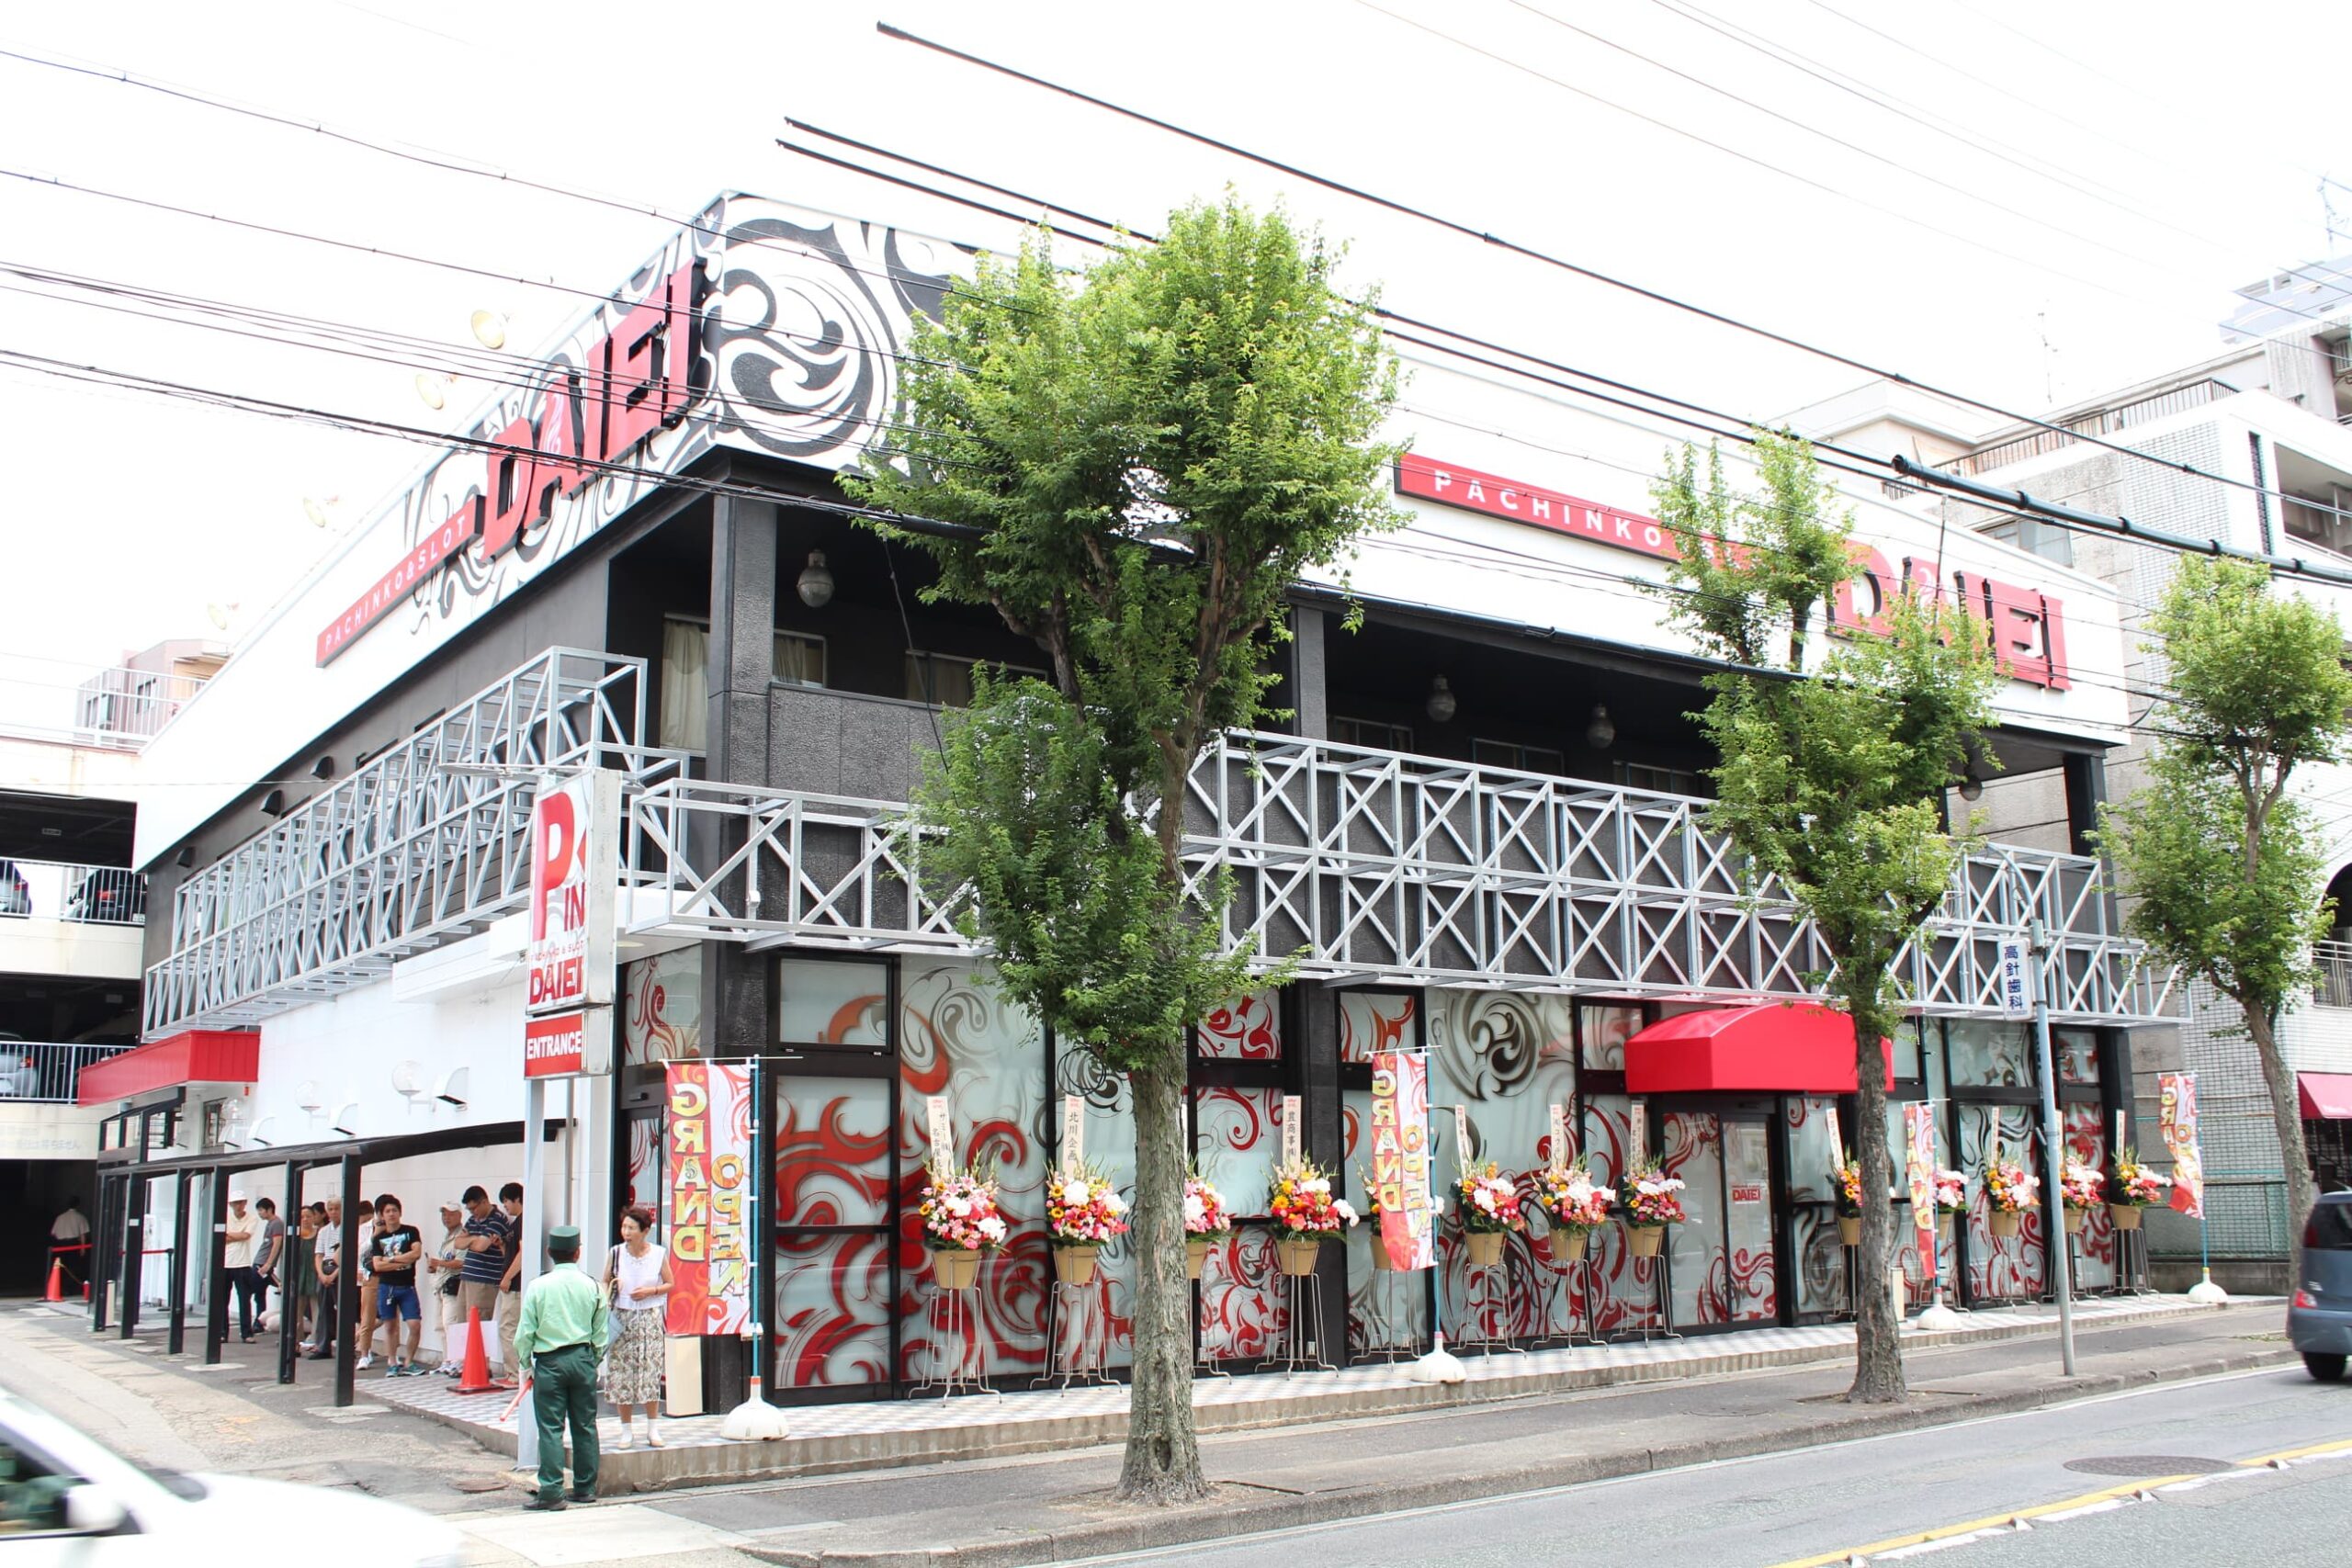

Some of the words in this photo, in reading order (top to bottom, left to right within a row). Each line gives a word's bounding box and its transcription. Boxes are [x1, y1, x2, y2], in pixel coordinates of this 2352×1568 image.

[480, 256, 698, 562] DAIEI
[529, 956, 583, 1006] DAIEI
[526, 1030, 582, 1060] ENTRANCE
[1068, 1111, 1080, 1161] 北川企画
